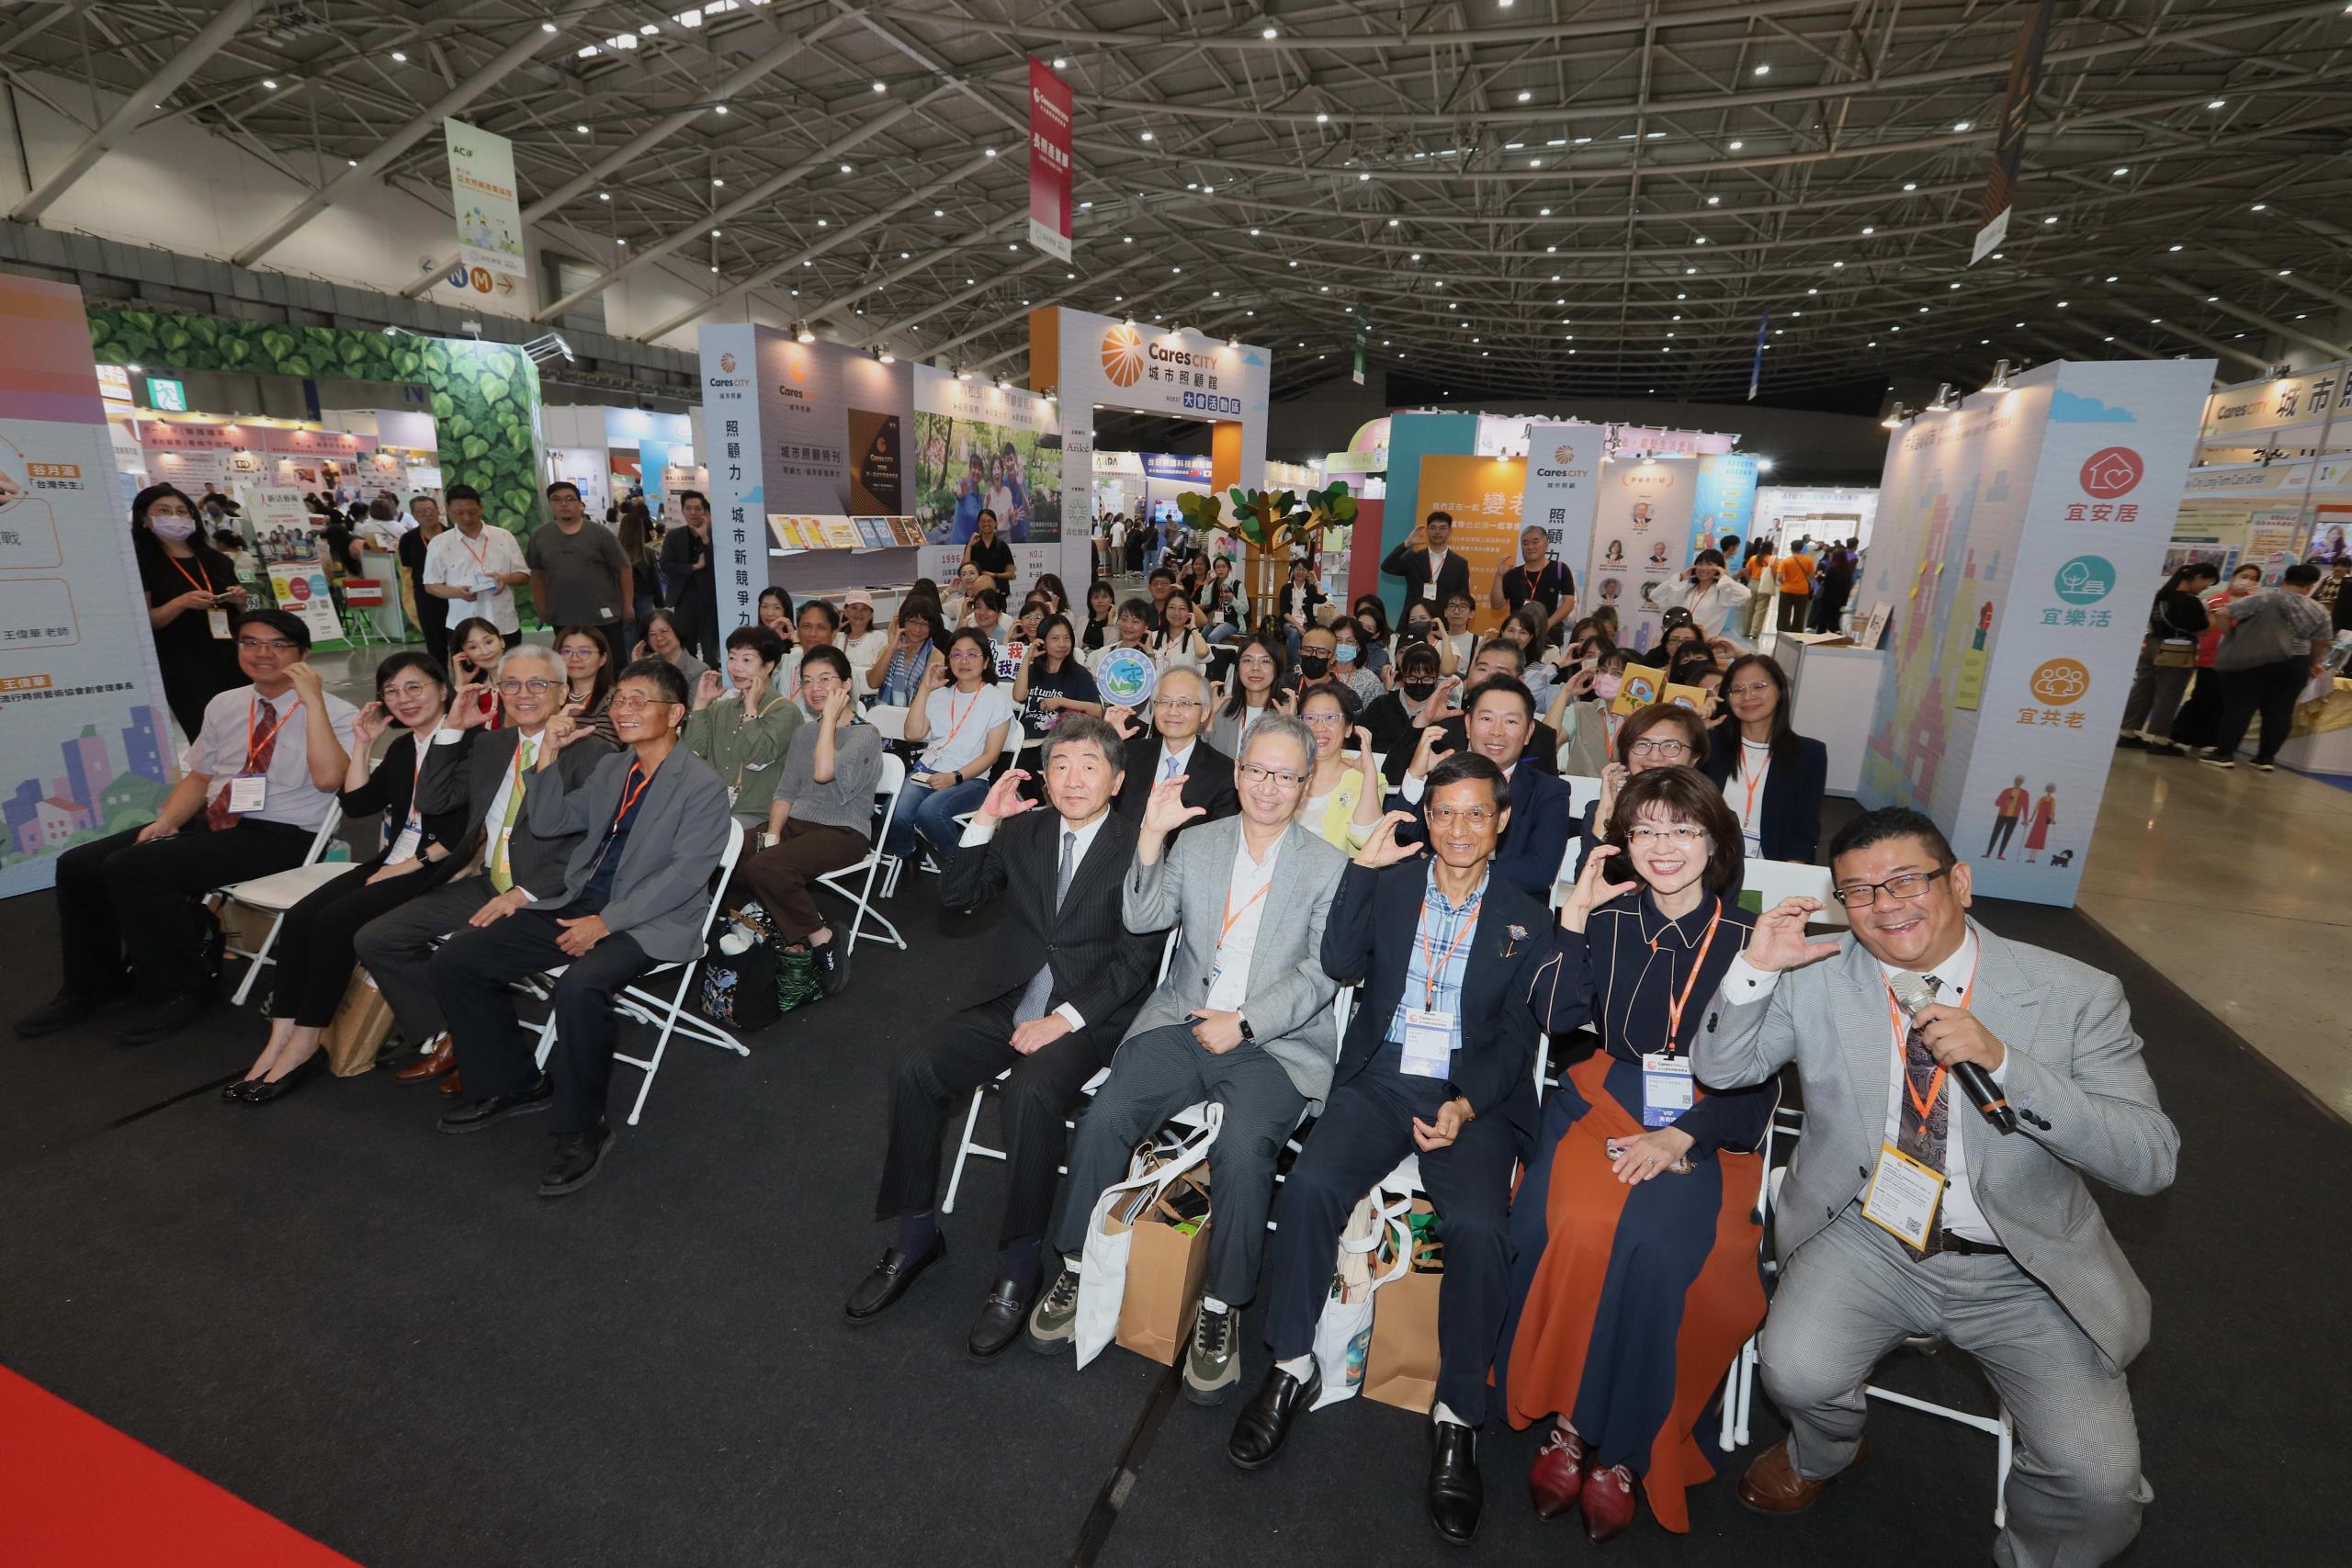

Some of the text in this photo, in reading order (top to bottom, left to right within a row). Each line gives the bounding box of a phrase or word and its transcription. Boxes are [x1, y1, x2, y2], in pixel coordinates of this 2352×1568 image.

[1148, 342, 1218, 369] CaresCITY
[710, 378, 750, 387] CaresCITY
[1148, 366, 1218, 389] 城市照顧館
[1183, 391, 1240, 414] 大會活動區
[1537, 468, 1589, 478] CaresCITY
[2064, 502, 2139, 523] 宜安居
[0, 531, 22, 546] 戰
[1545, 508, 1566, 562] 照顧力
[2040, 607, 2112, 628] 宜樂活
[45, 626, 70, 637] 老師
[2016, 707, 2086, 728] 宜共老
